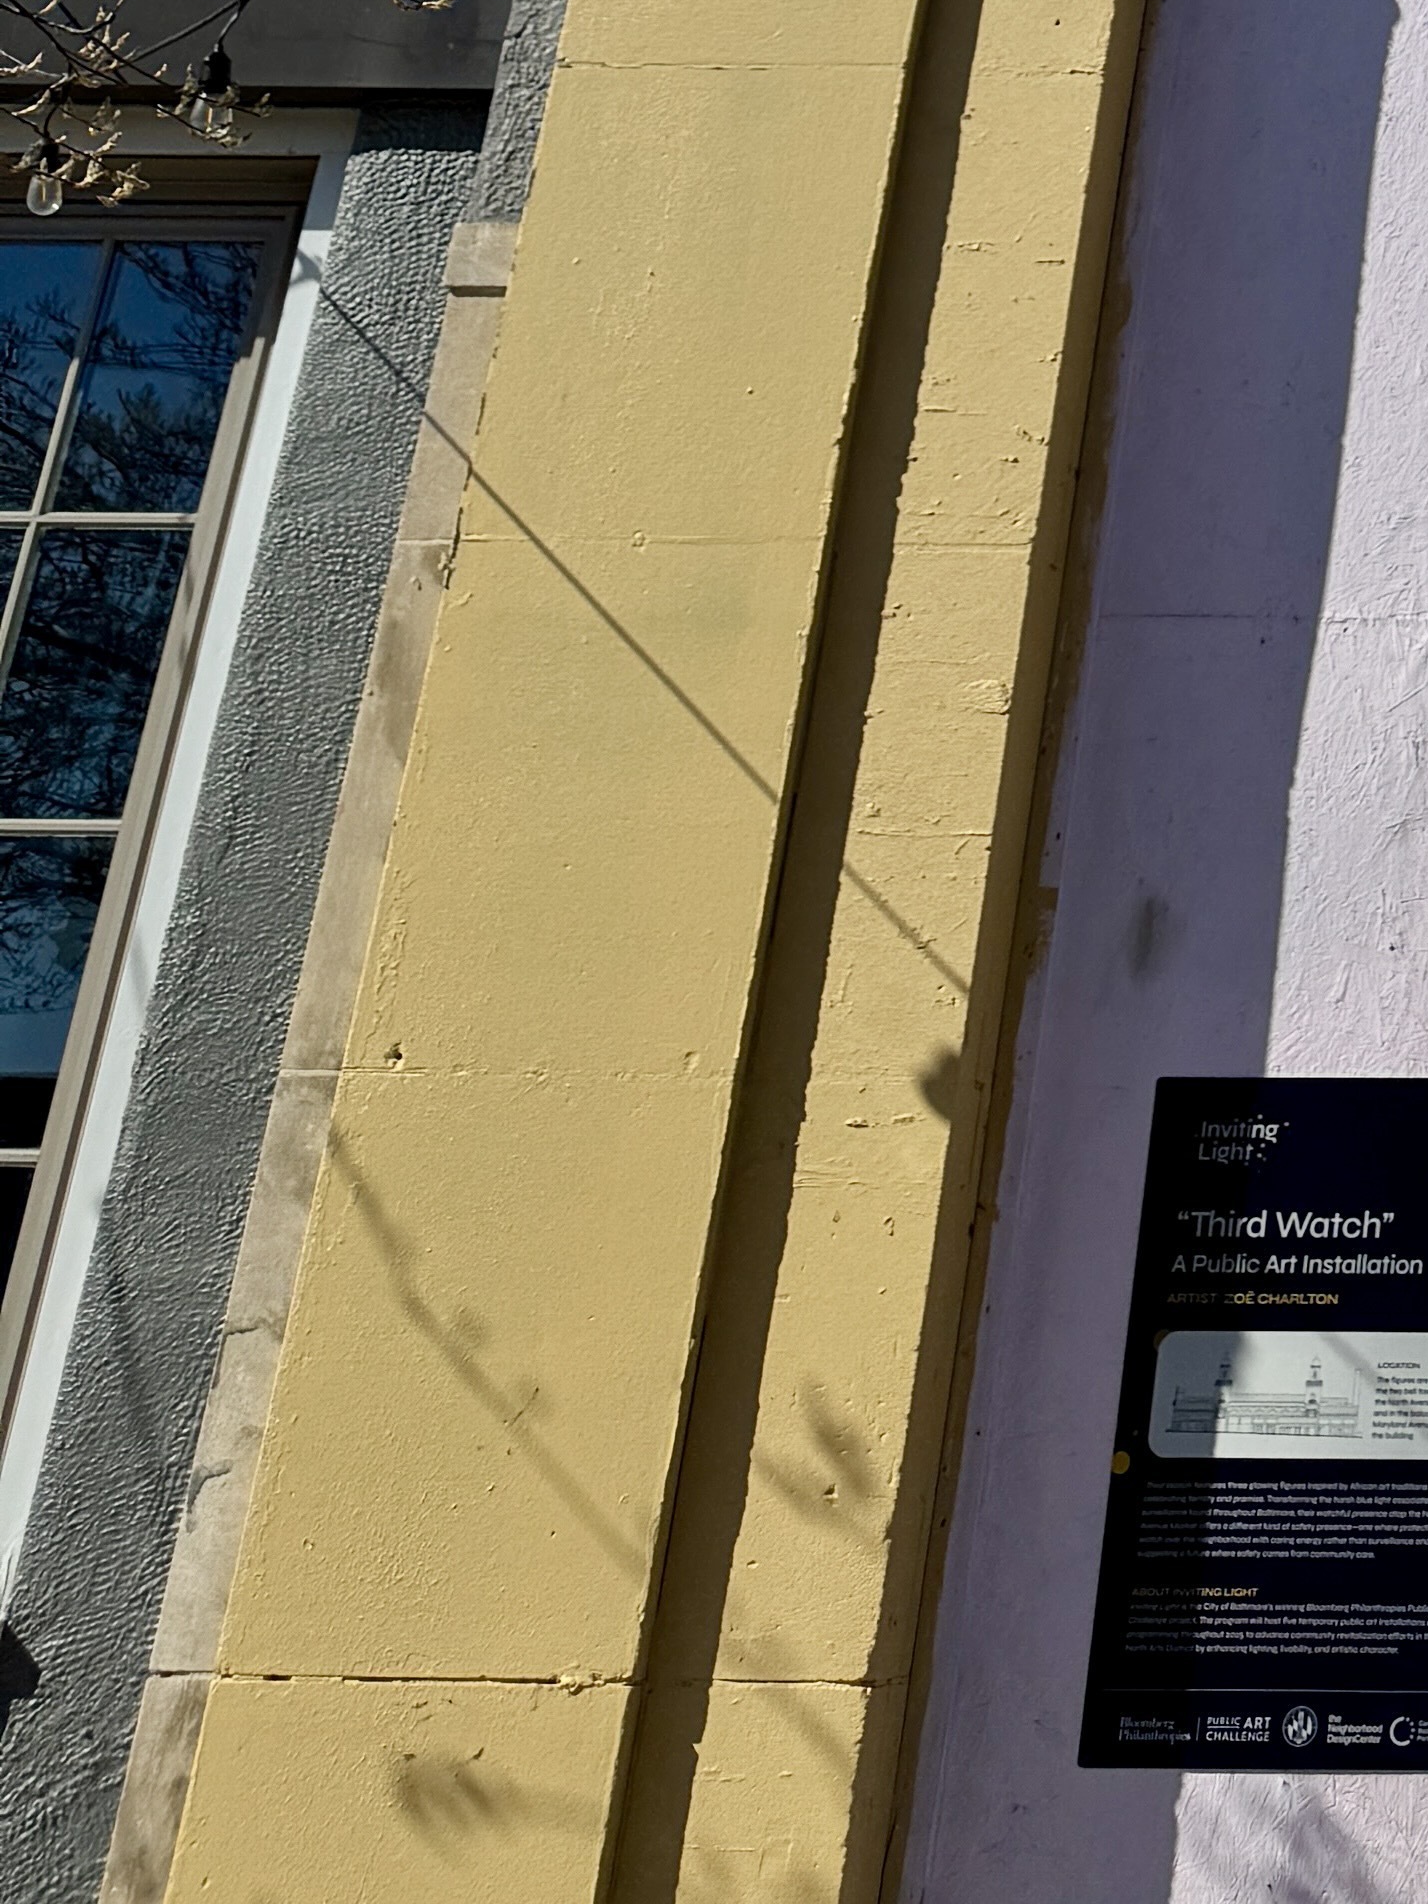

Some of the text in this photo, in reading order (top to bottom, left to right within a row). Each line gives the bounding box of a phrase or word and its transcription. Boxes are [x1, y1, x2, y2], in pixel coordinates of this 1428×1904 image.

[1201, 1119, 1279, 1143] Inviting
[1199, 1142, 1254, 1163] Light
[1171, 1254, 1424, 1274] A Public Art Installation
[1257, 1293, 1339, 1304] CHARLTON
[1223, 1588, 1259, 1597] LIGHT
[1207, 1717, 1271, 1729] PUBLIC ART
[1206, 1731, 1270, 1742] CHALLENGE
